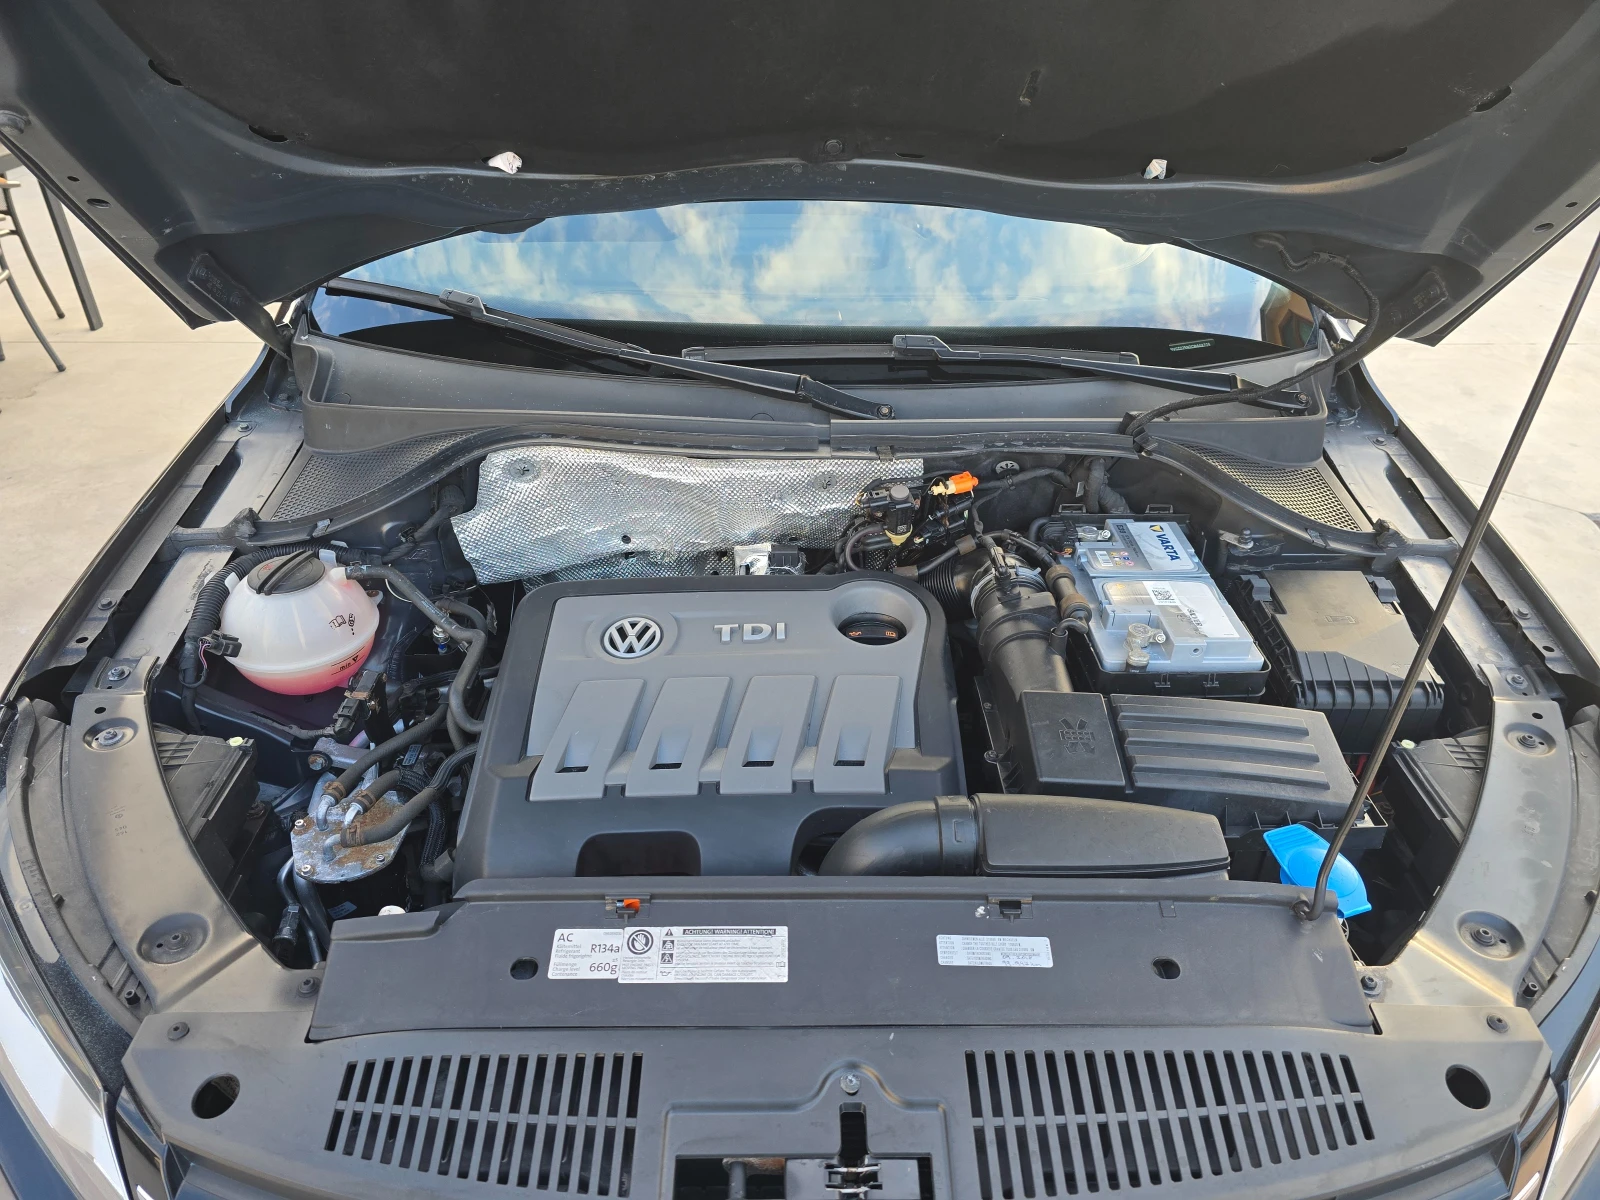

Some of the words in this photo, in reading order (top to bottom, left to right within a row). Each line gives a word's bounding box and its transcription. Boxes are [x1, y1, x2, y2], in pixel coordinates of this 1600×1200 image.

[1156, 533, 1181, 561] VARTA
[713, 622, 787, 643] TDI
[557, 933, 574, 942] AC
[590, 943, 620, 953] R134a
[589, 962, 618, 975] 660g
